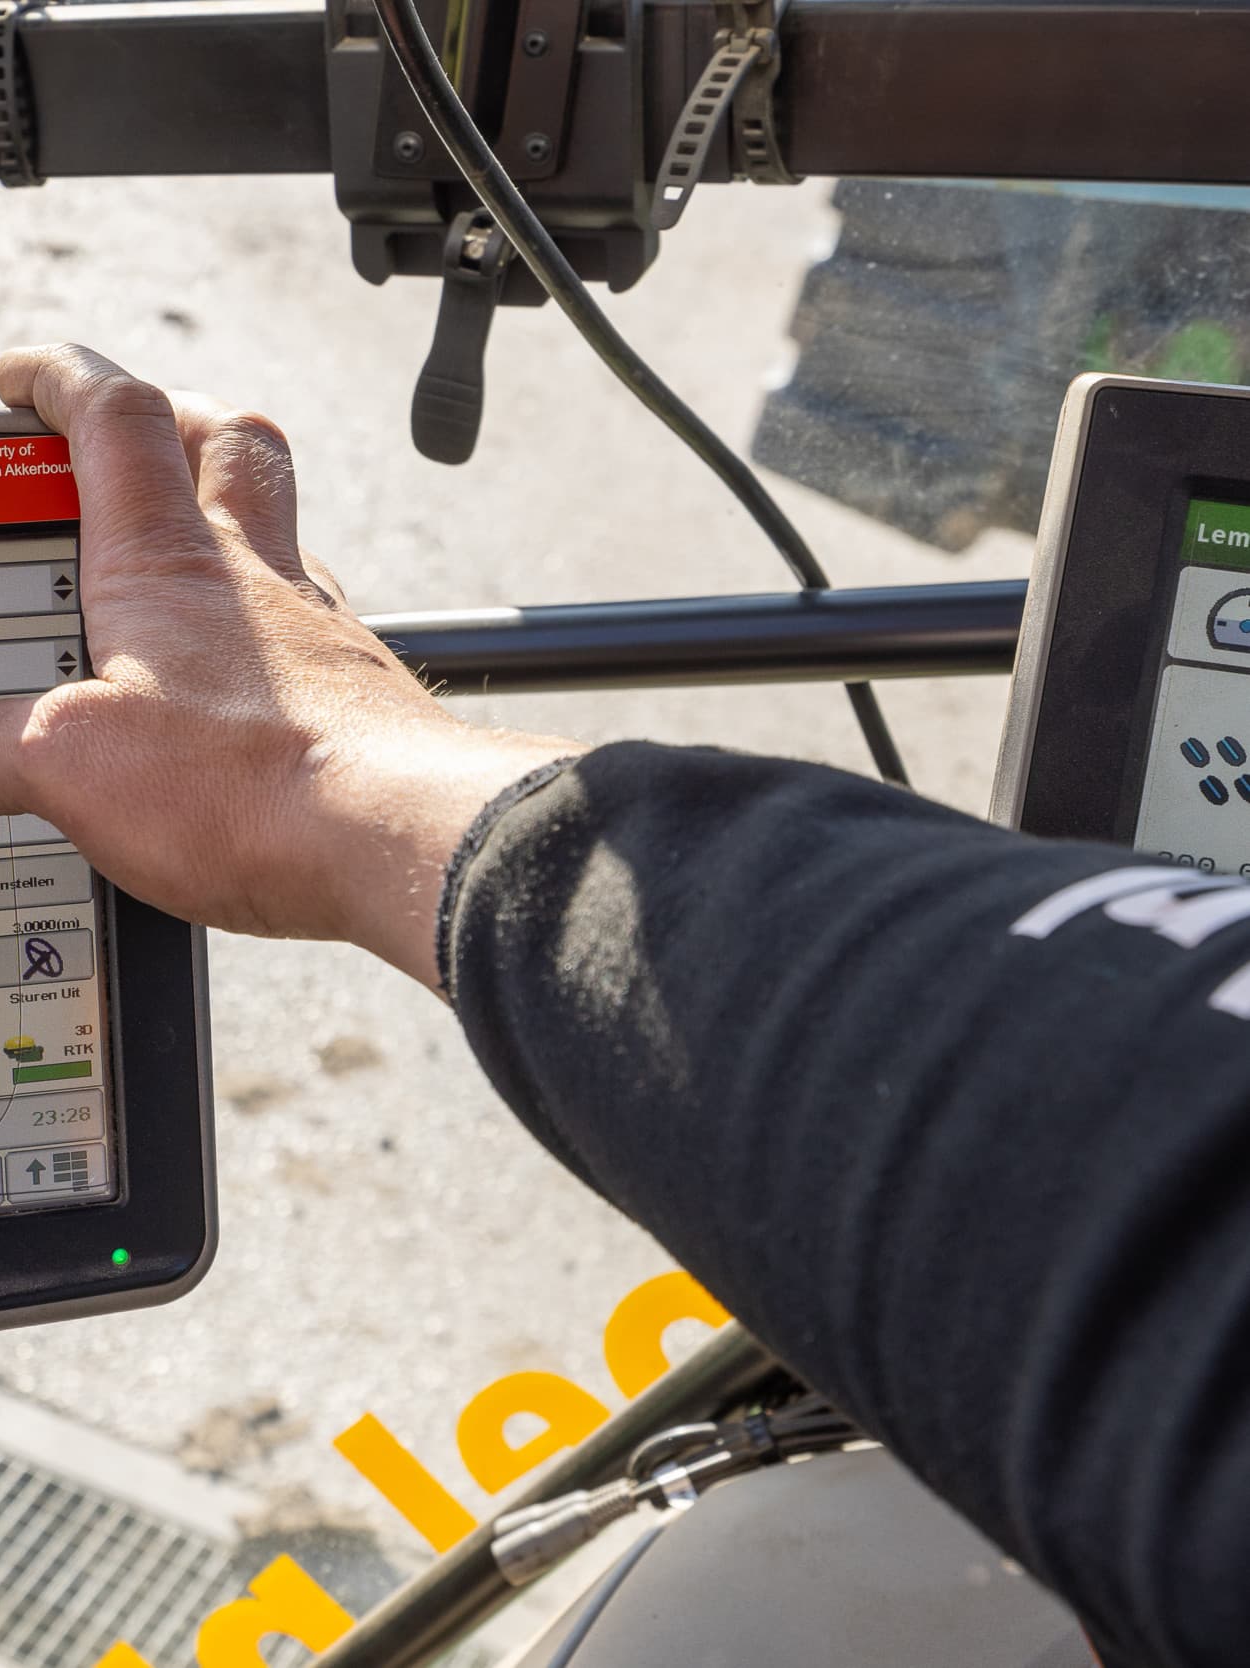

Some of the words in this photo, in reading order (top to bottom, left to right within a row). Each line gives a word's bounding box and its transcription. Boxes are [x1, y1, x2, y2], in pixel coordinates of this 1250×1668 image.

[19, 443, 35, 456] of:
[1197, 523, 1250, 548] Lem
[10, 991, 57, 1004] Sturen
[61, 987, 81, 999] Uit
[74, 1024, 93, 1036] 3D
[64, 1043, 94, 1057] RTK
[32, 1107, 91, 1127] 23:28
